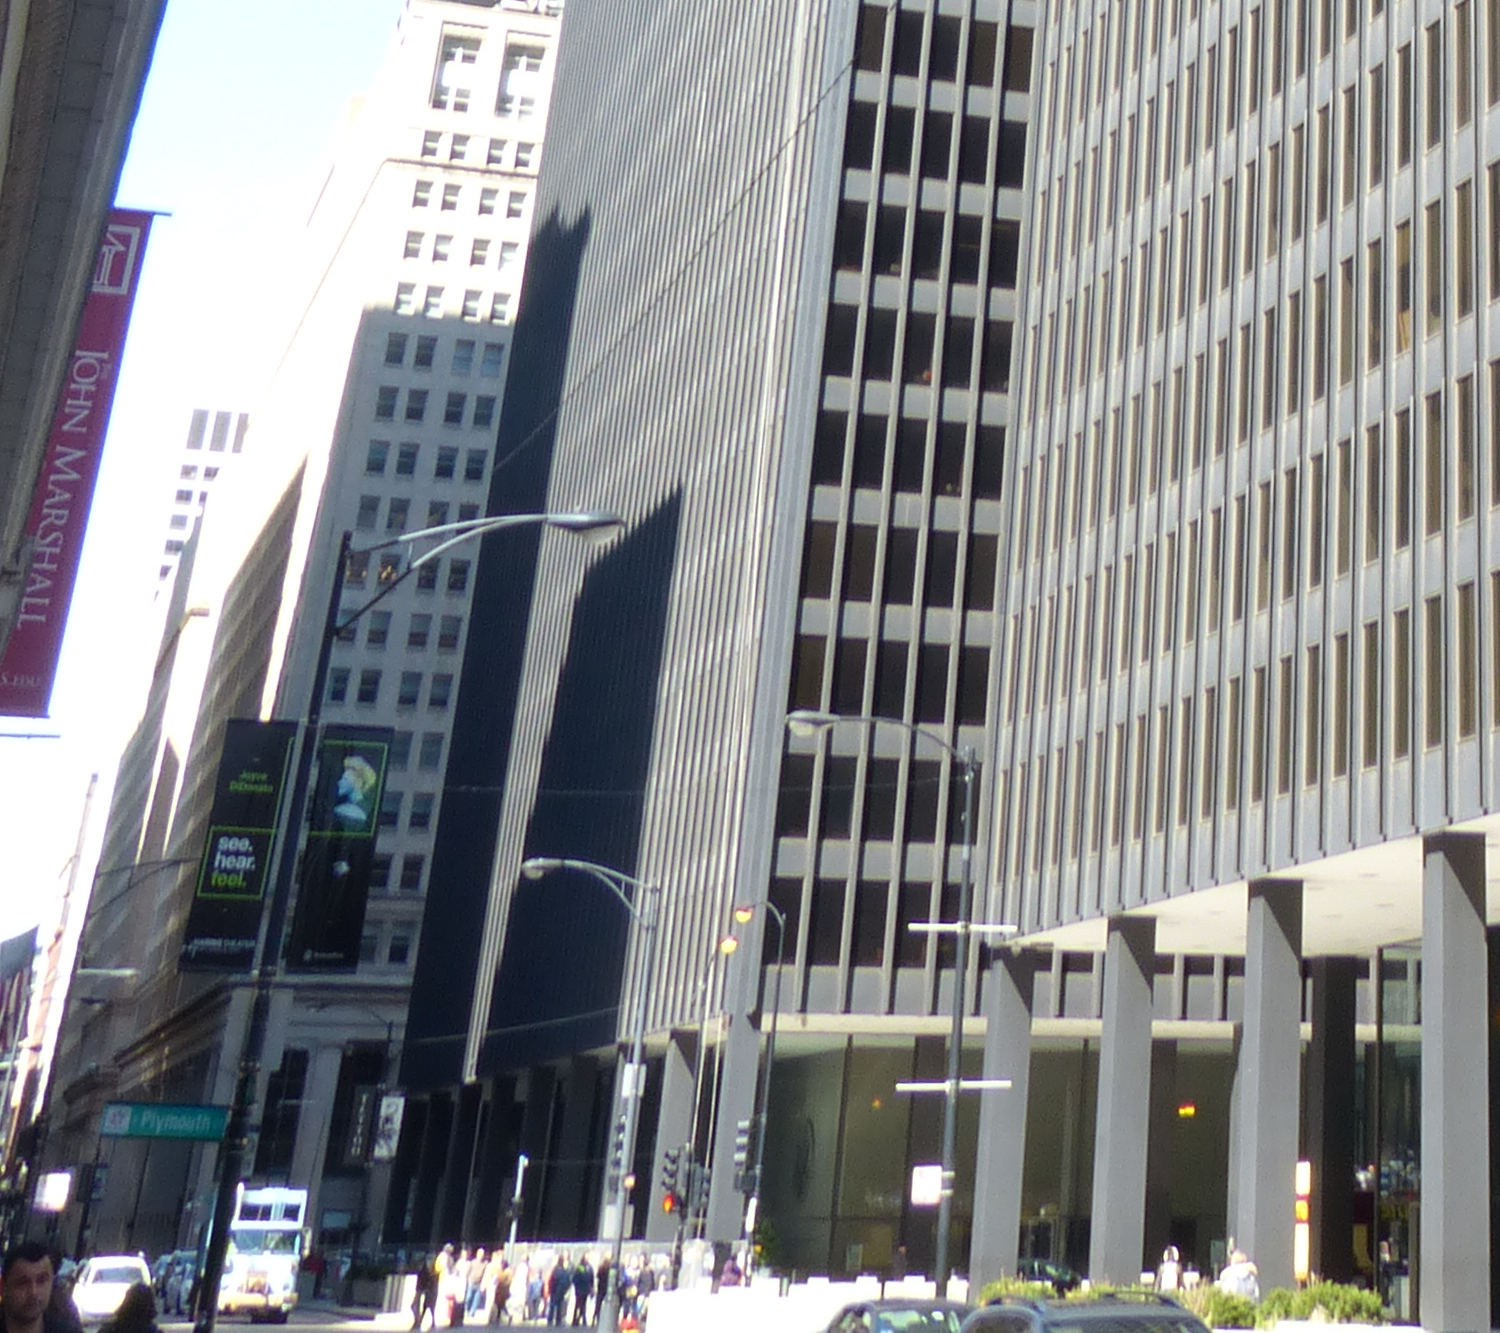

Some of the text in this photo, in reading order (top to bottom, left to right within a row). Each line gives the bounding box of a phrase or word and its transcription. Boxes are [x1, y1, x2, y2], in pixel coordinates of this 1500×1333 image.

[18, 350, 109, 629] JOHN MARSHALL
[217, 836, 254, 852] see.
[214, 850, 256, 871] hear.
[210, 869, 247, 888] feel.
